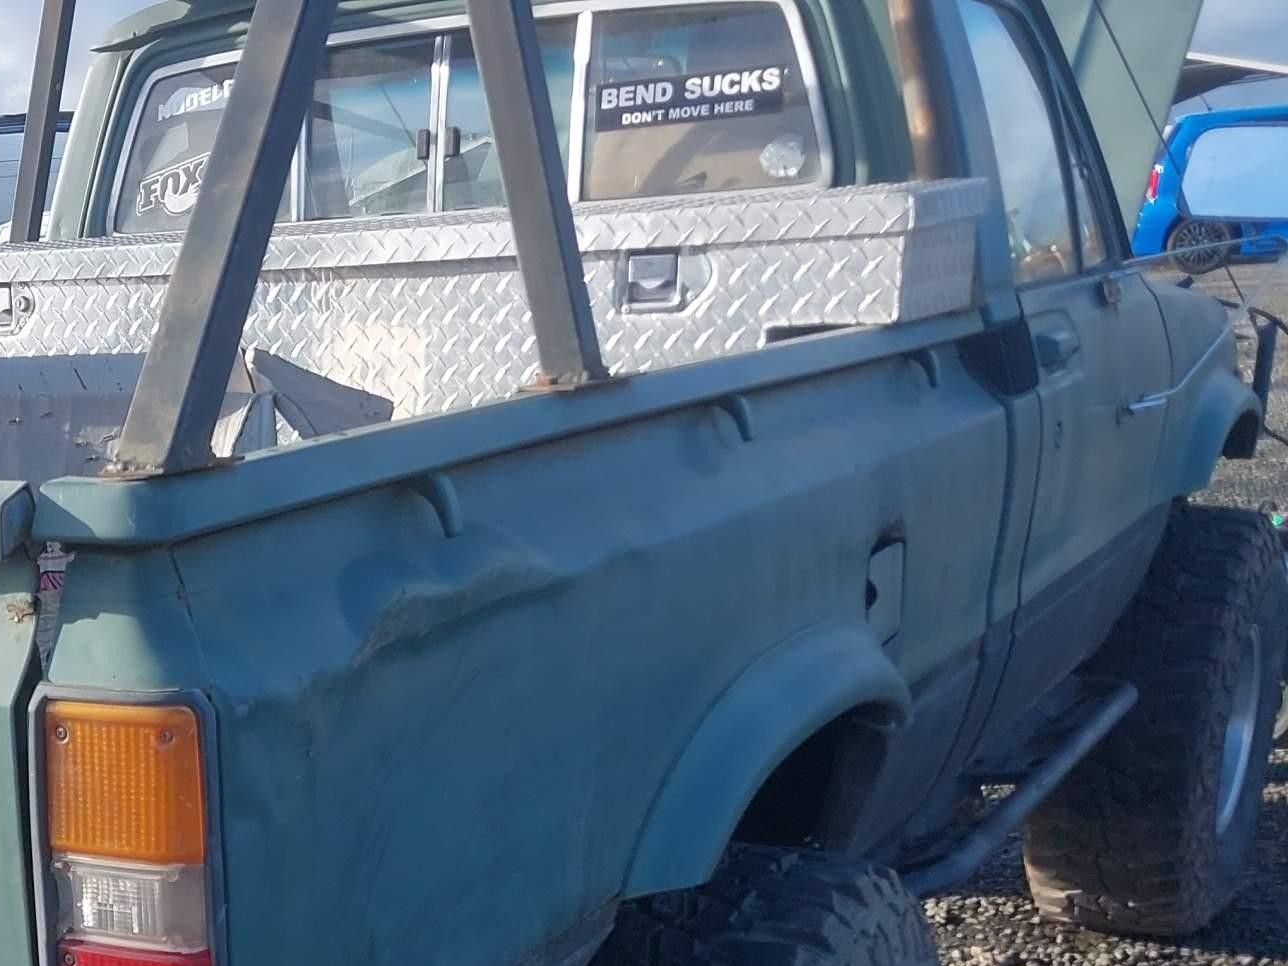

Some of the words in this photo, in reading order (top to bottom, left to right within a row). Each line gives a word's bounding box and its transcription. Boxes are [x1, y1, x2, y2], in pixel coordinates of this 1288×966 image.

[601, 82, 674, 109] BEND
[684, 67, 781, 99] SUCKS
[621, 109, 665, 125] DON'T
[668, 103, 710, 120] MOVE
[714, 99, 754, 114] HERE
[137, 152, 211, 213] FOX
